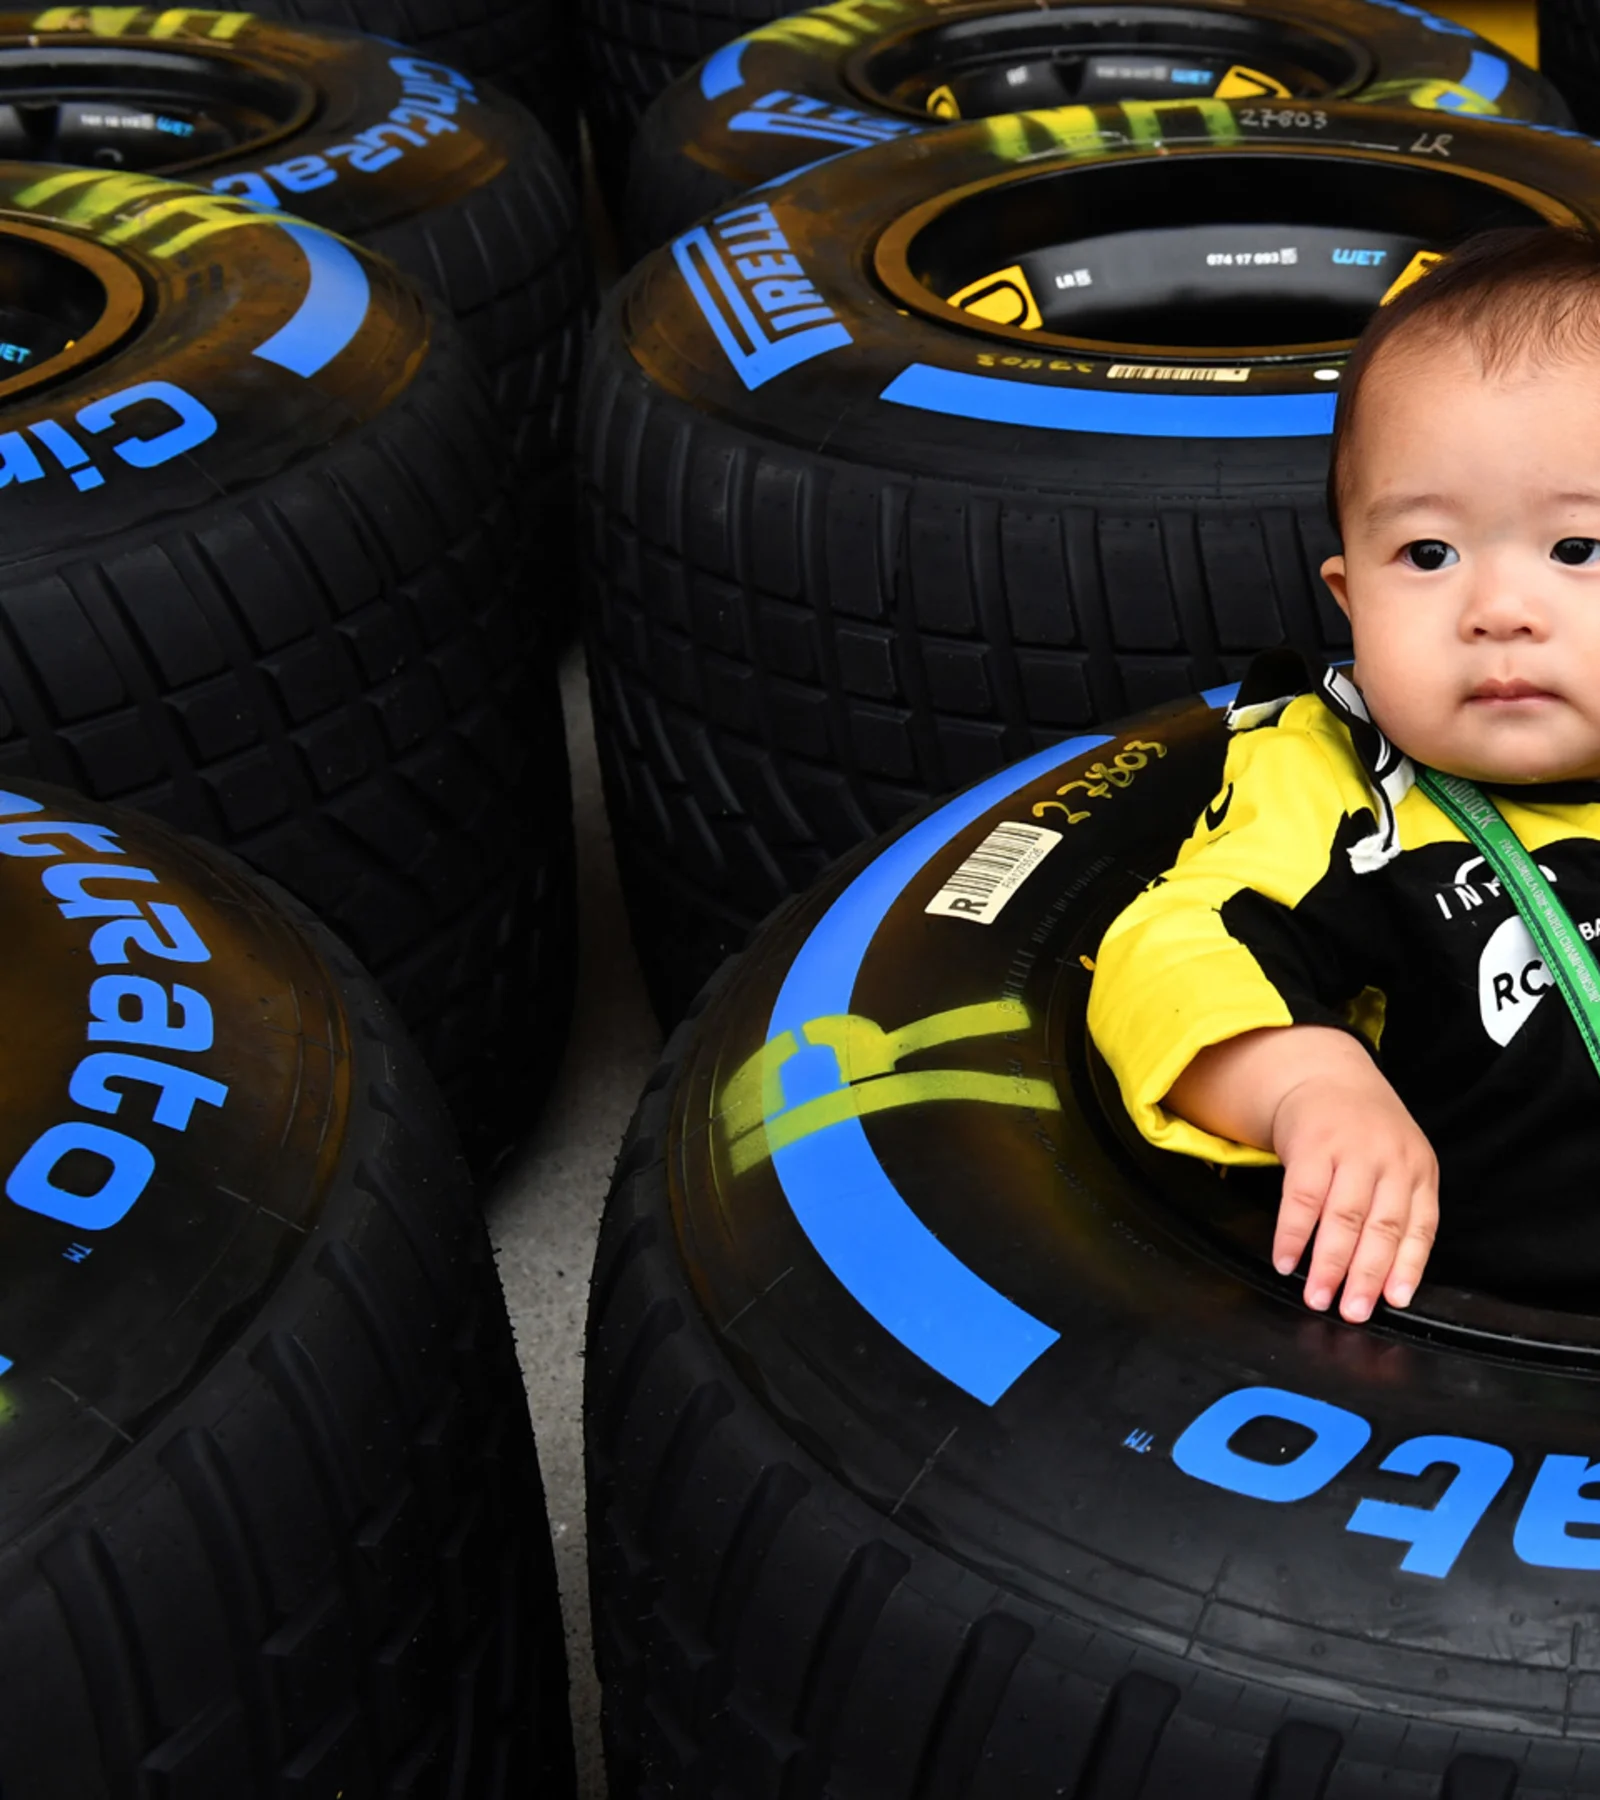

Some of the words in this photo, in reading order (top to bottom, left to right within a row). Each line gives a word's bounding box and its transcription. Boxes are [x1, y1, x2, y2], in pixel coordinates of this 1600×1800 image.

[1410, 133, 1454, 156] LR
[1333, 248, 1386, 267] WET
[672, 203, 852, 391] PIRELLI
[1506, 848, 1539, 893] FORMULA
[1531, 888, 1550, 909] ONE
[1542, 906, 1566, 938] WORLD
[949, 897, 989, 917] R
